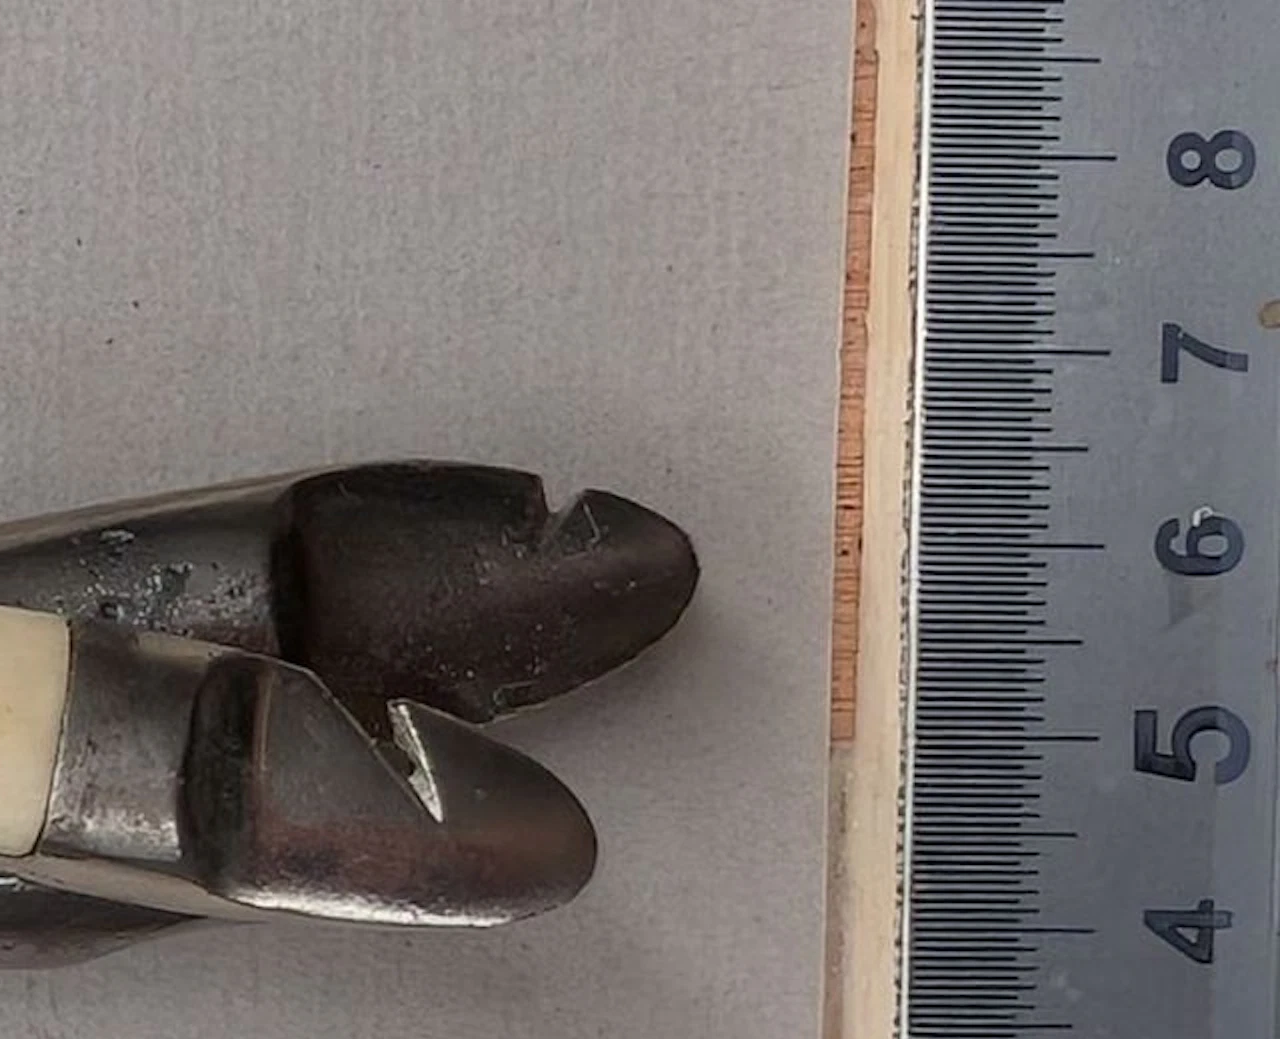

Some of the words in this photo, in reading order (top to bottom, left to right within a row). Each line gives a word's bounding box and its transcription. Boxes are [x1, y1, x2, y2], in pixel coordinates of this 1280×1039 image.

[1166, 130, 1256, 190] 8
[1161, 322, 1248, 384] 7
[1154, 515, 1245, 576] 6
[1133, 706, 1250, 784] 5
[1143, 899, 1232, 964] 4
